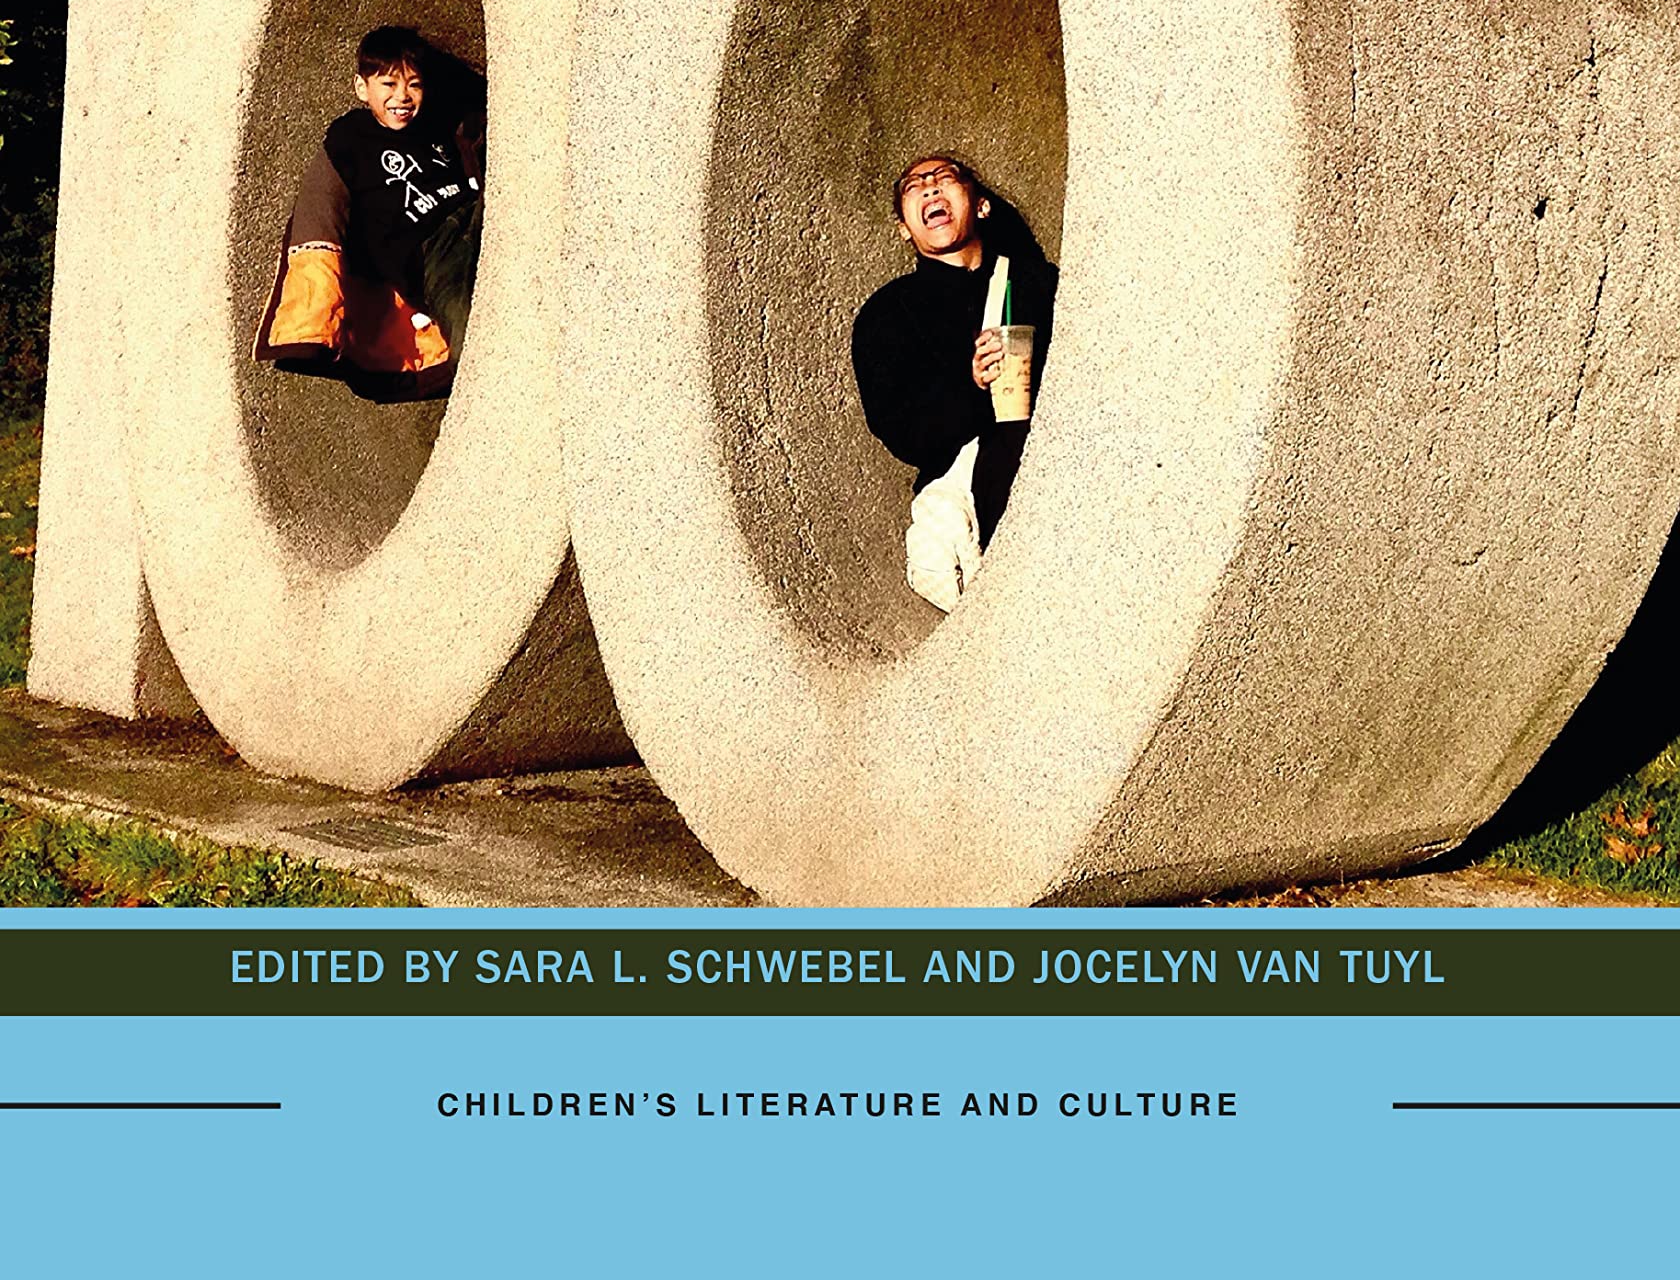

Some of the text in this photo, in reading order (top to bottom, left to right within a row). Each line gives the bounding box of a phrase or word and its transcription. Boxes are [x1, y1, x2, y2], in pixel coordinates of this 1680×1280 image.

[232, 950, 1444, 983] EDITED BY SARA L. SCHWEBEL AND JOCELYN VAN TUYL
[438, 1093, 1236, 1117] CHILDREN’S LITERATURE AND CULTURE
